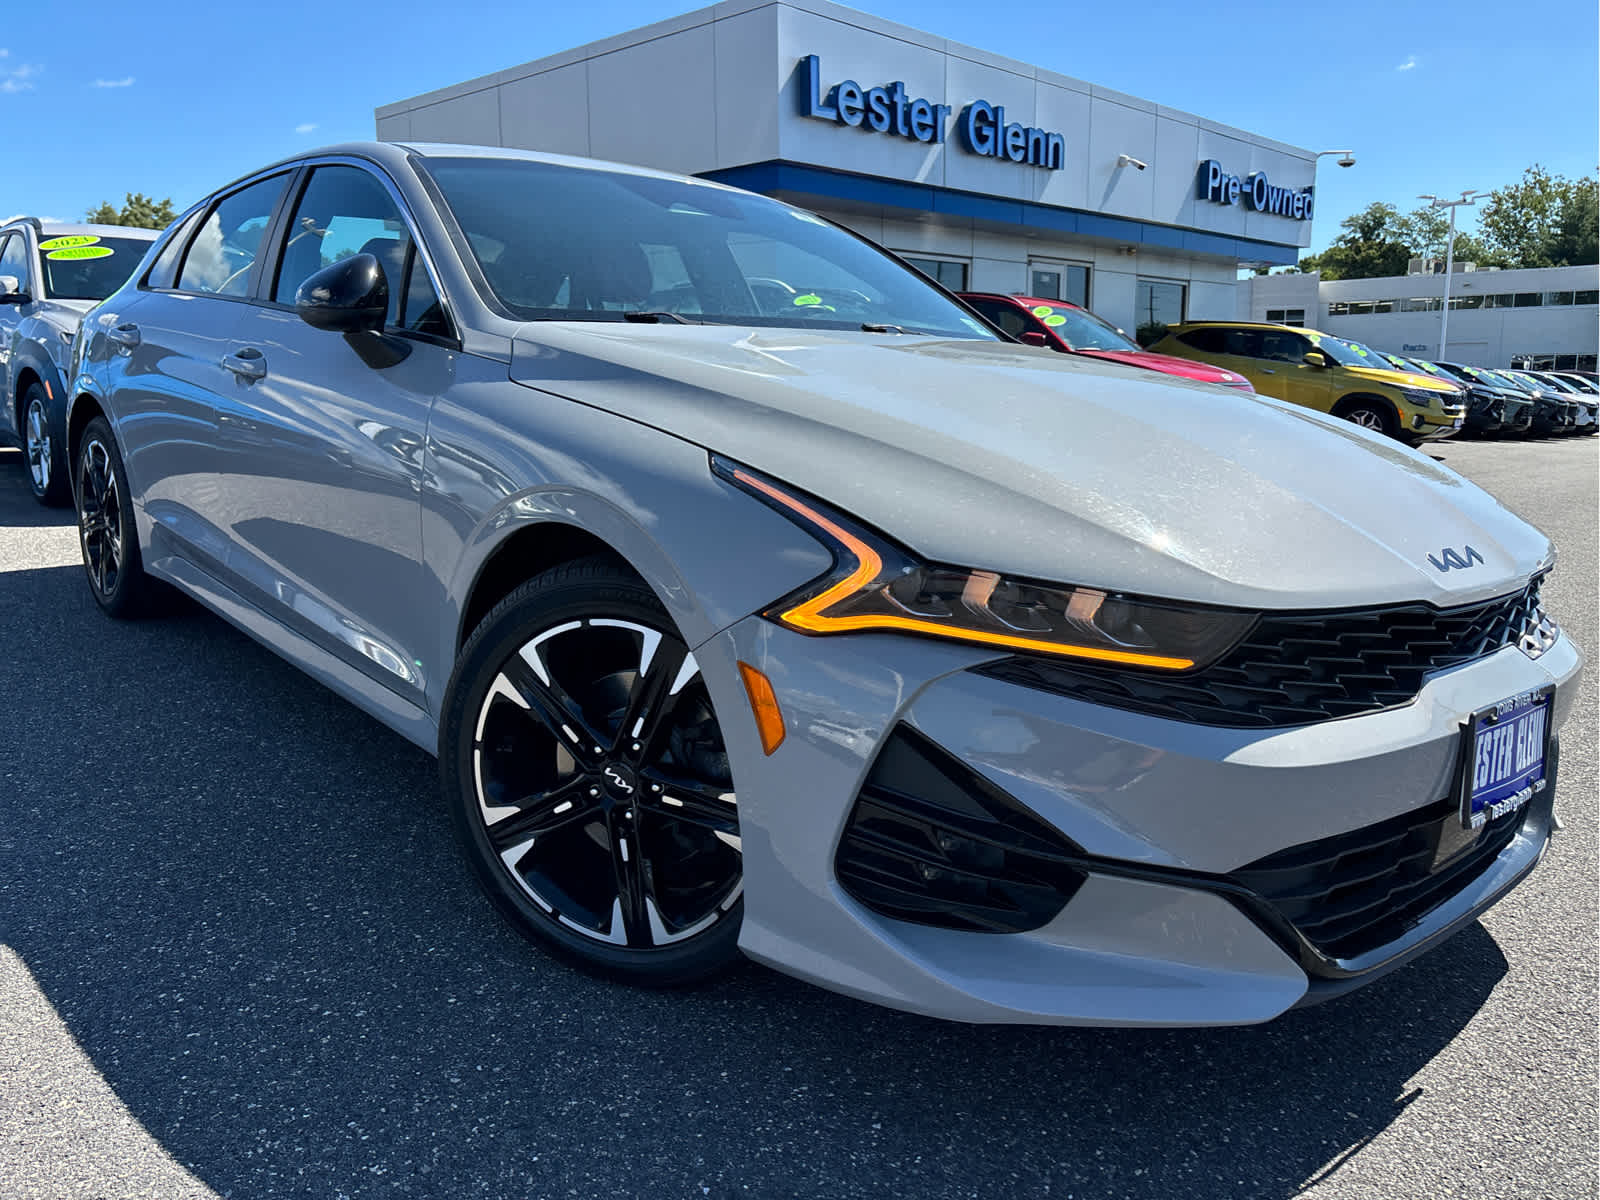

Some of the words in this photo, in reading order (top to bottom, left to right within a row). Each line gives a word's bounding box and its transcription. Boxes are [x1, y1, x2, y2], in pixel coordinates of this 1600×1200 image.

[799, 55, 951, 145] Lester
[959, 99, 1065, 171] Glenn
[1199, 159, 1315, 221] Pre-Owned
[1473, 724, 1514, 791] ESTER
[1516, 707, 1547, 773] GLENN
